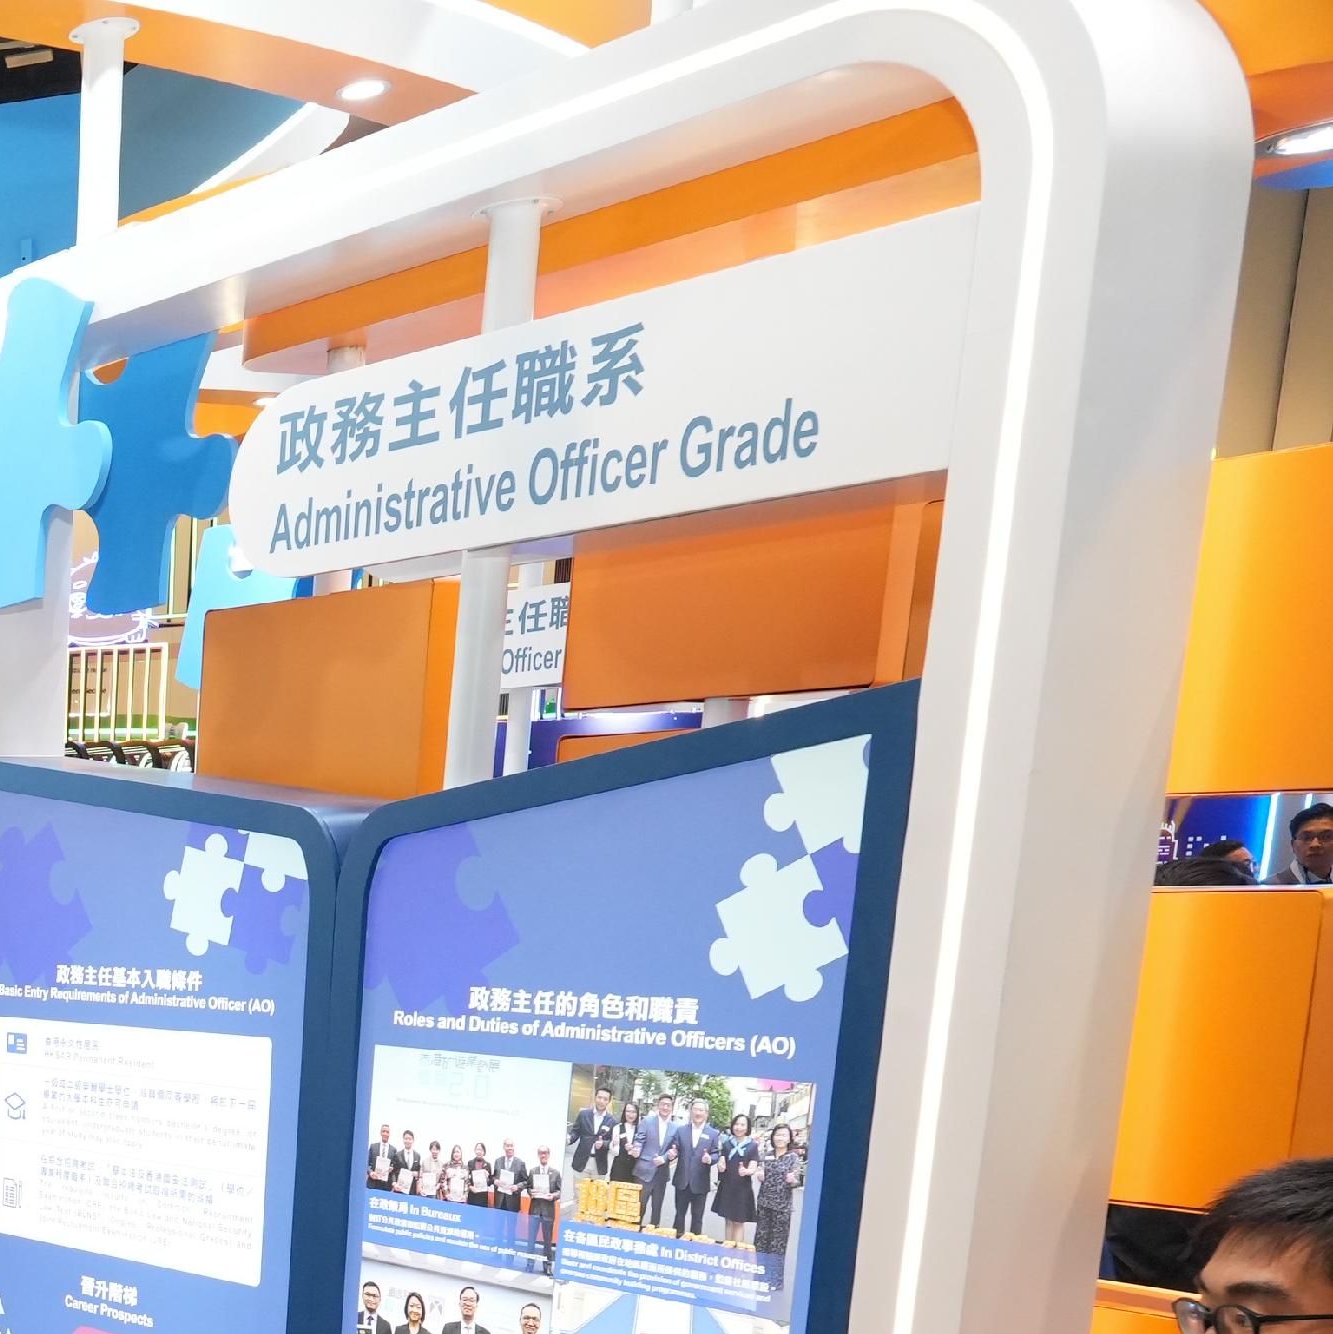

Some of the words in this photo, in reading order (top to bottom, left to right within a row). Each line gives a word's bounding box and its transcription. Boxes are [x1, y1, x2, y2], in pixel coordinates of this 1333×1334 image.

[277, 322, 645, 475] 政務主任職系
[269, 463, 515, 554] Administrative
[528, 439, 669, 506] Officer
[681, 397, 820, 479] Grade
[501, 646, 562, 675] Officer
[25, 985, 48, 1002] Entry
[50, 987, 116, 1005] Requirements
[118, 991, 130, 1004] of
[131, 992, 206, 1010] Administrative
[208, 996, 247, 1012] Officer
[248, 998, 276, 1017] (AO)
[468, 986, 699, 1025] 政務主任的角色和職責
[393, 1010, 434, 1028] Roles
[436, 1013, 465, 1031] and
[468, 1015, 518, 1035] Duties
[521, 1019, 540, 1037] of
[541, 1021, 666, 1046] Administrative
[671, 1030, 745, 1052] Officers
[750, 1033, 797, 1060] (AO)
[422, 1206, 462, 1223] Bureaux
[660, 1246, 673, 1258] In
[675, 1248, 719, 1268] District
[720, 1257, 766, 1275] Offices
[65, 1294, 98, 1315] Career
[100, 1302, 154, 1328] Prospects
